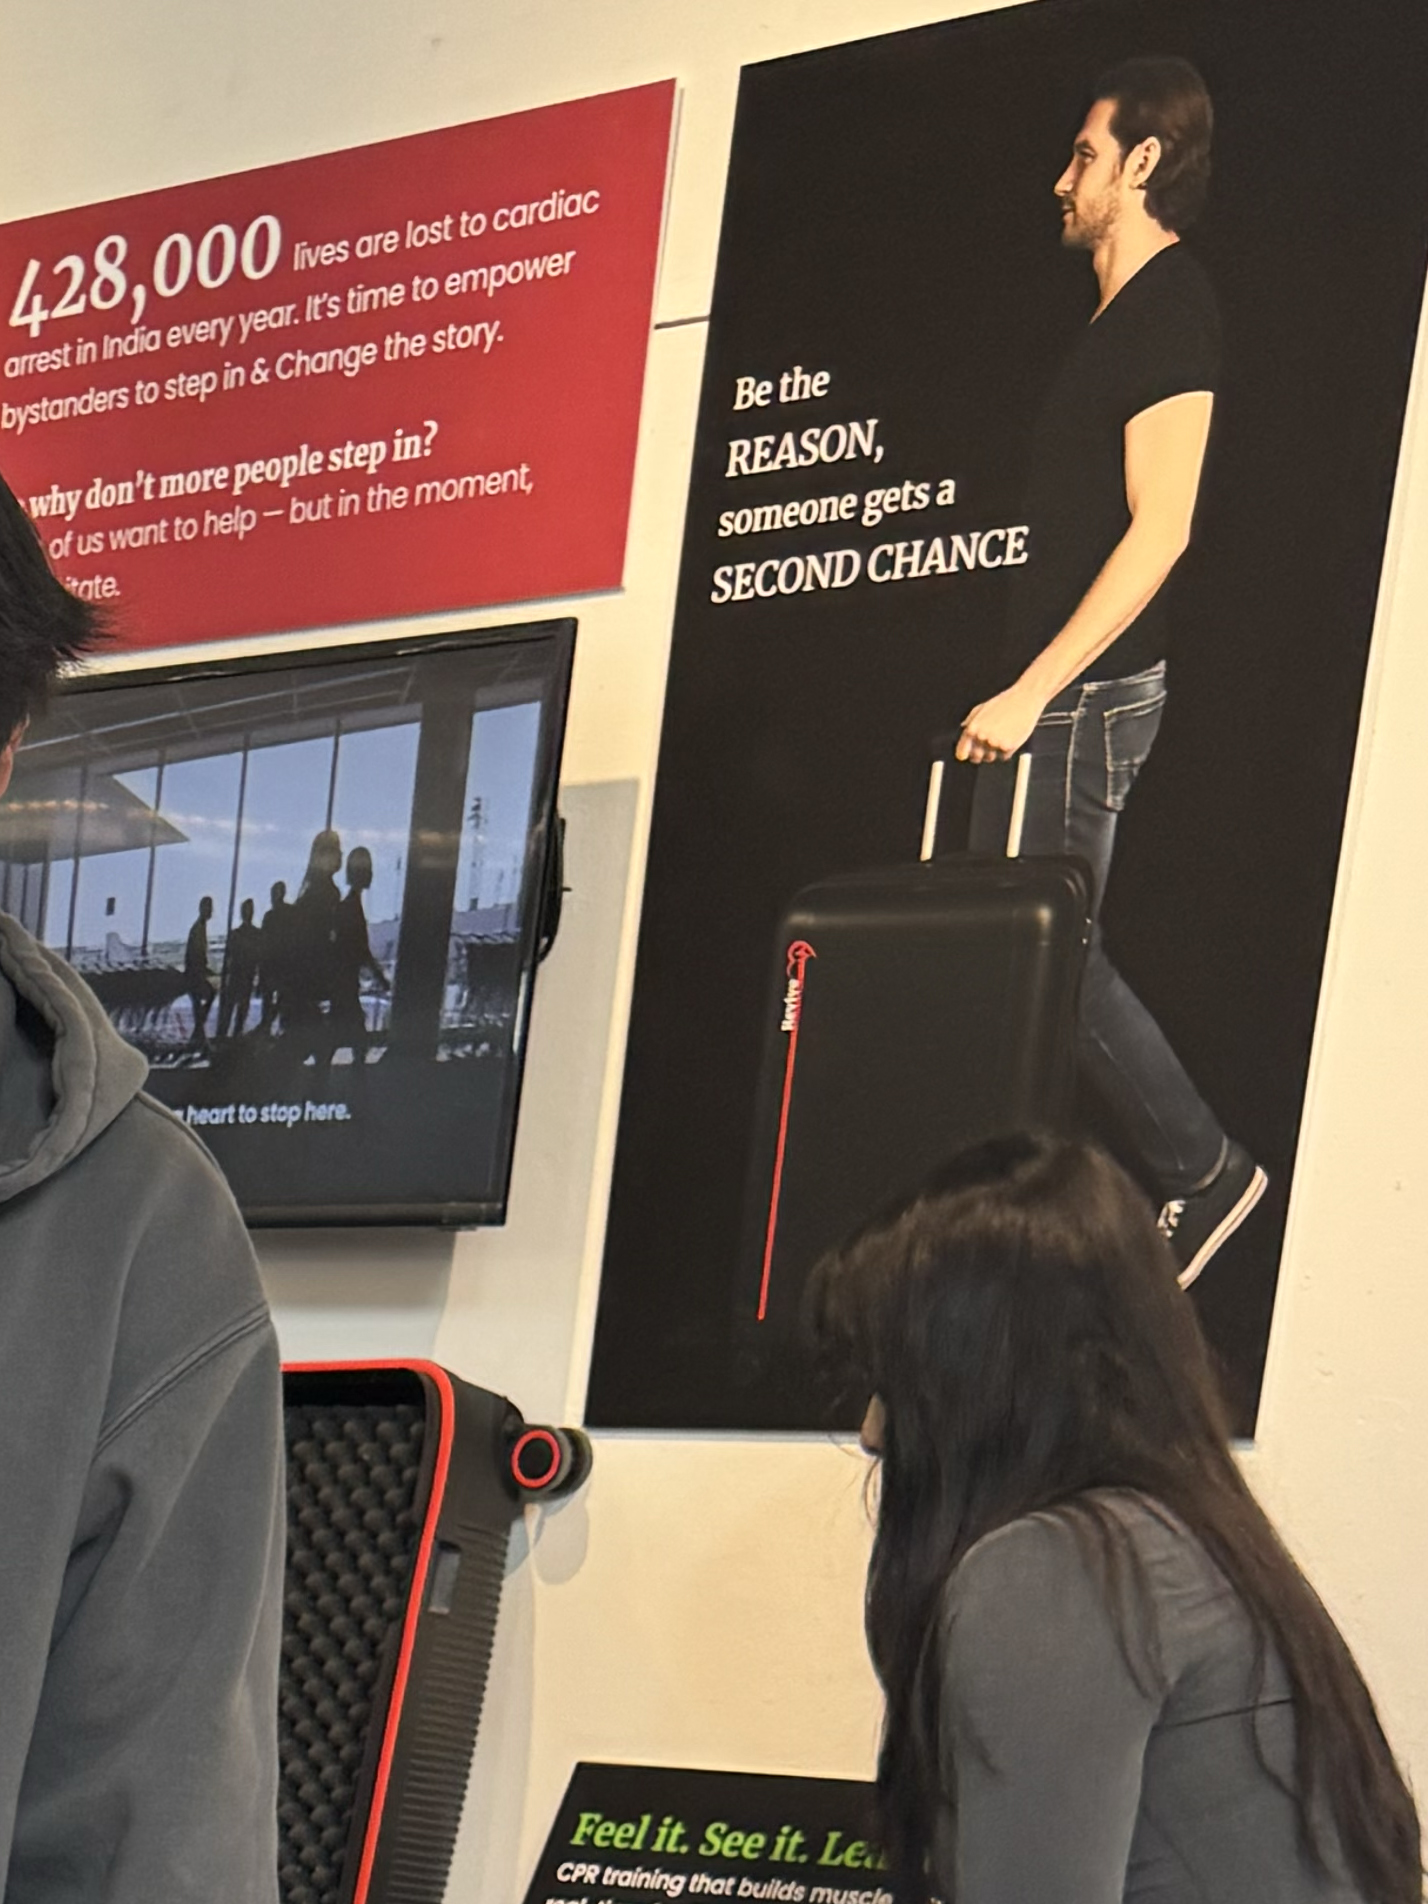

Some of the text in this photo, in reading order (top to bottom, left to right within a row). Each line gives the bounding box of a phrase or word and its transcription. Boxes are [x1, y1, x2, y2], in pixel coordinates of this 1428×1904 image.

[9, 189, 600, 337] 428,000 lives are lost to cardiac
[4, 250, 576, 377] arrest in India every year. It's time to empower
[1, 319, 504, 435] bystanders to step in & Change the story.
[733, 365, 831, 411] Be the
[29, 484, 82, 521] why
[85, 468, 155, 509] don't
[158, 464, 229, 499] more
[232, 443, 323, 495] people
[328, 440, 387, 475] step
[391, 420, 438, 462] in?
[725, 418, 885, 478] REASON,
[48, 529, 73, 560] of
[76, 530, 104, 556] us
[109, 518, 169, 550] want
[173, 515, 199, 542] to
[202, 505, 257, 541] help
[289, 492, 332, 524] but
[337, 488, 360, 517] in
[366, 483, 409, 512] the
[414, 462, 534, 507] moment,
[718, 477, 957, 538] someone gets a
[710, 525, 1031, 604] SECOND CHANCE
[186, 1103, 236, 1126] heart
[237, 1103, 258, 1124] to
[260, 1102, 302, 1128] stop
[303, 1100, 352, 1123] here.
[569, 1812, 653, 1850] Feel
[651, 1816, 689, 1854] it.
[698, 1821, 766, 1860] See
[768, 1825, 808, 1864] it.
[556, 1861, 601, 1885] CPR
[602, 1865, 687, 1898] training
[688, 1872, 737, 1896] that
[737, 1876, 807, 1902] builds
